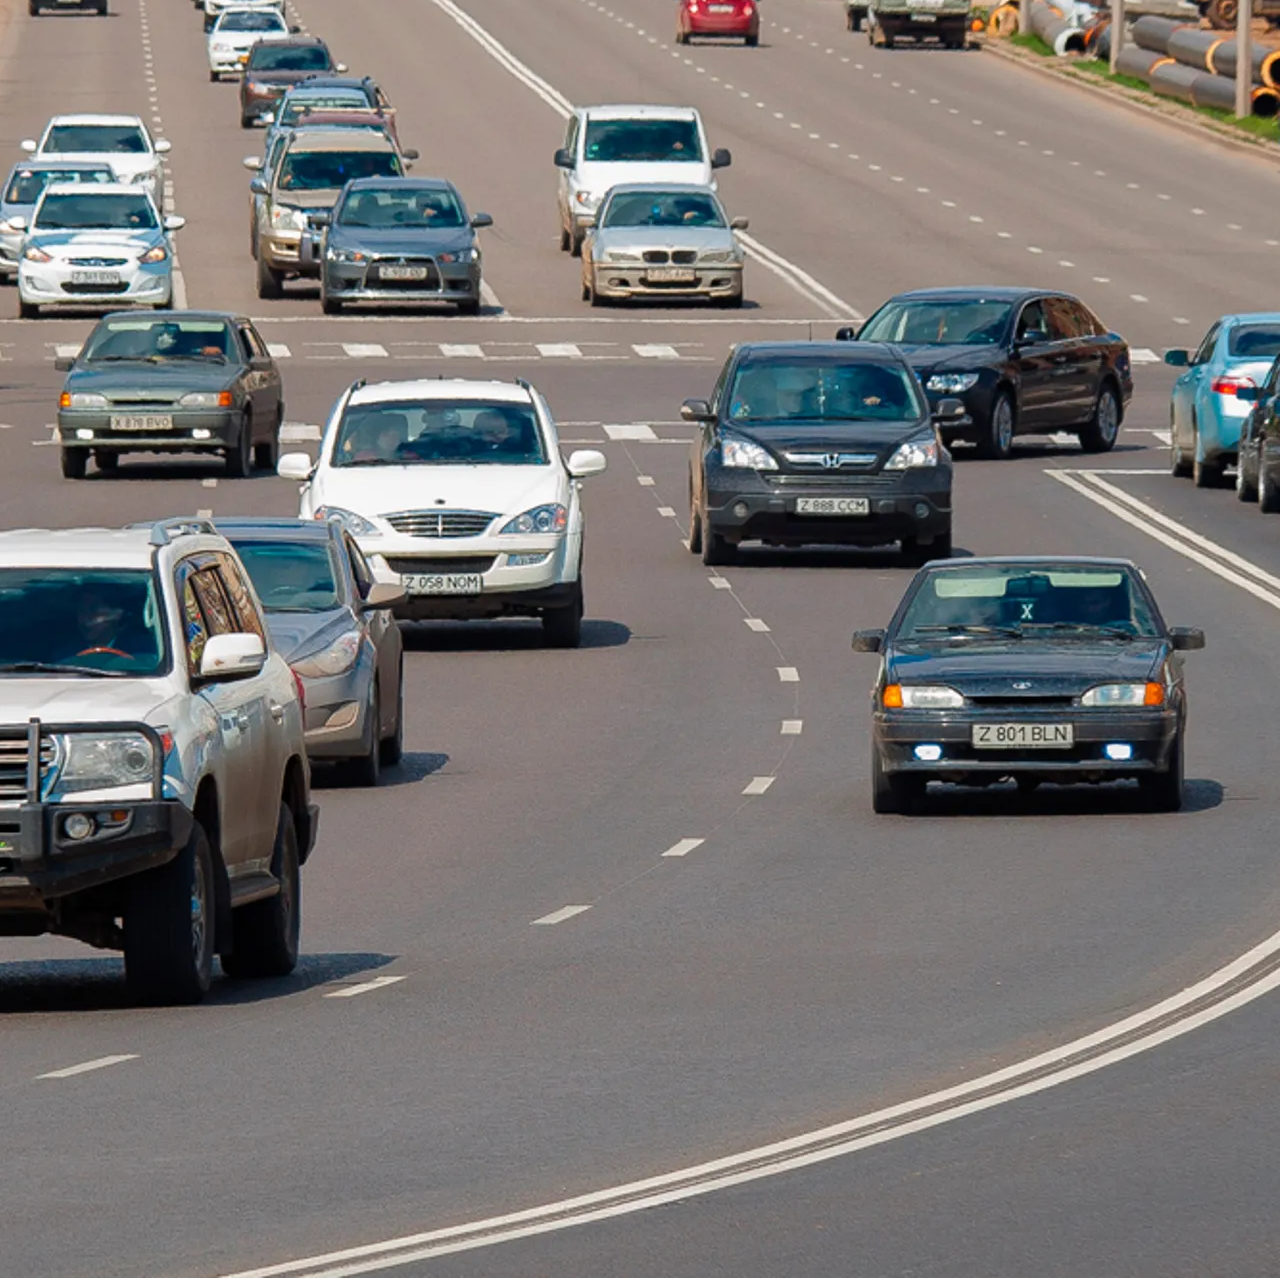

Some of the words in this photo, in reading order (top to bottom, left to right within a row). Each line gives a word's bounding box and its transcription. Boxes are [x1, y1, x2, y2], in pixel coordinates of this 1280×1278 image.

[800, 500, 809, 511] Z
[405, 576, 414, 589] Z
[419, 576, 443, 590] 058
[446, 576, 478, 589] NOM
[978, 726, 991, 742] Z
[996, 726, 1026, 742] 801
[1031, 726, 1068, 742] BLN
